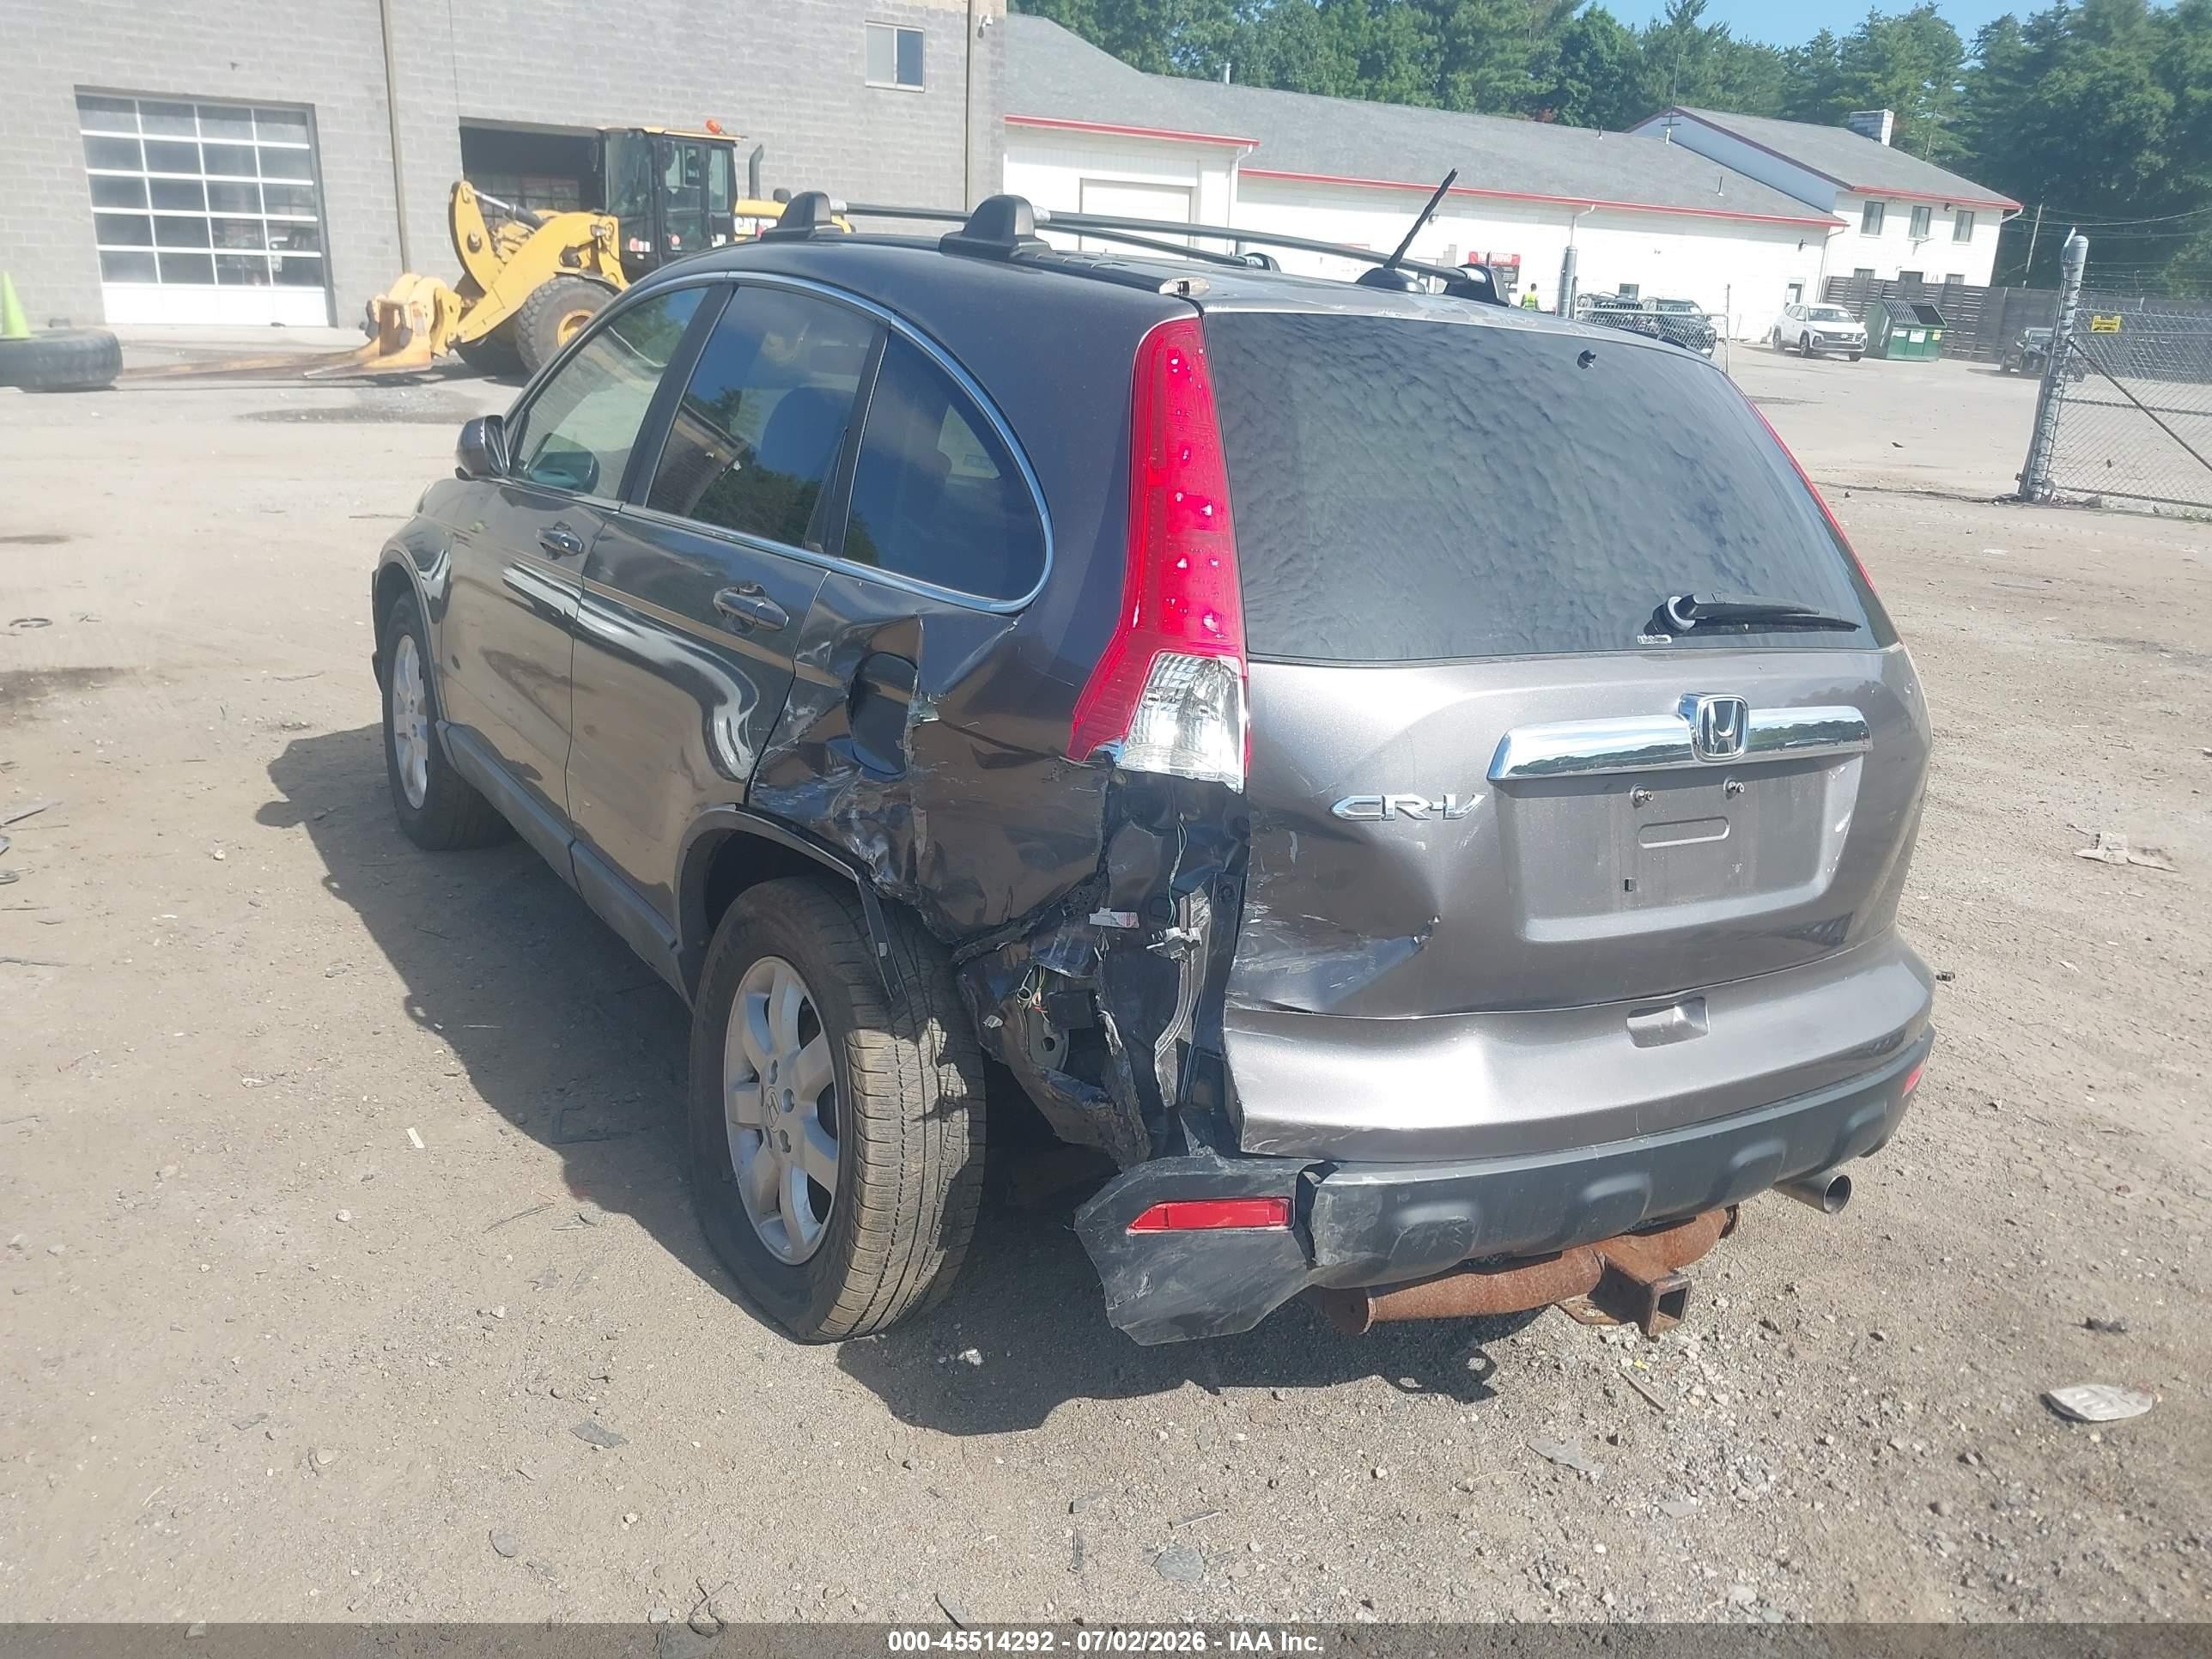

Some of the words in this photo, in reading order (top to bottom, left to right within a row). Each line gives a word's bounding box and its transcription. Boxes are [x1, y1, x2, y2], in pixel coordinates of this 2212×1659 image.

[733, 216, 757, 235] CAT
[1477, 252, 1512, 263] WANING
[1329, 793, 1487, 821] CR-V
